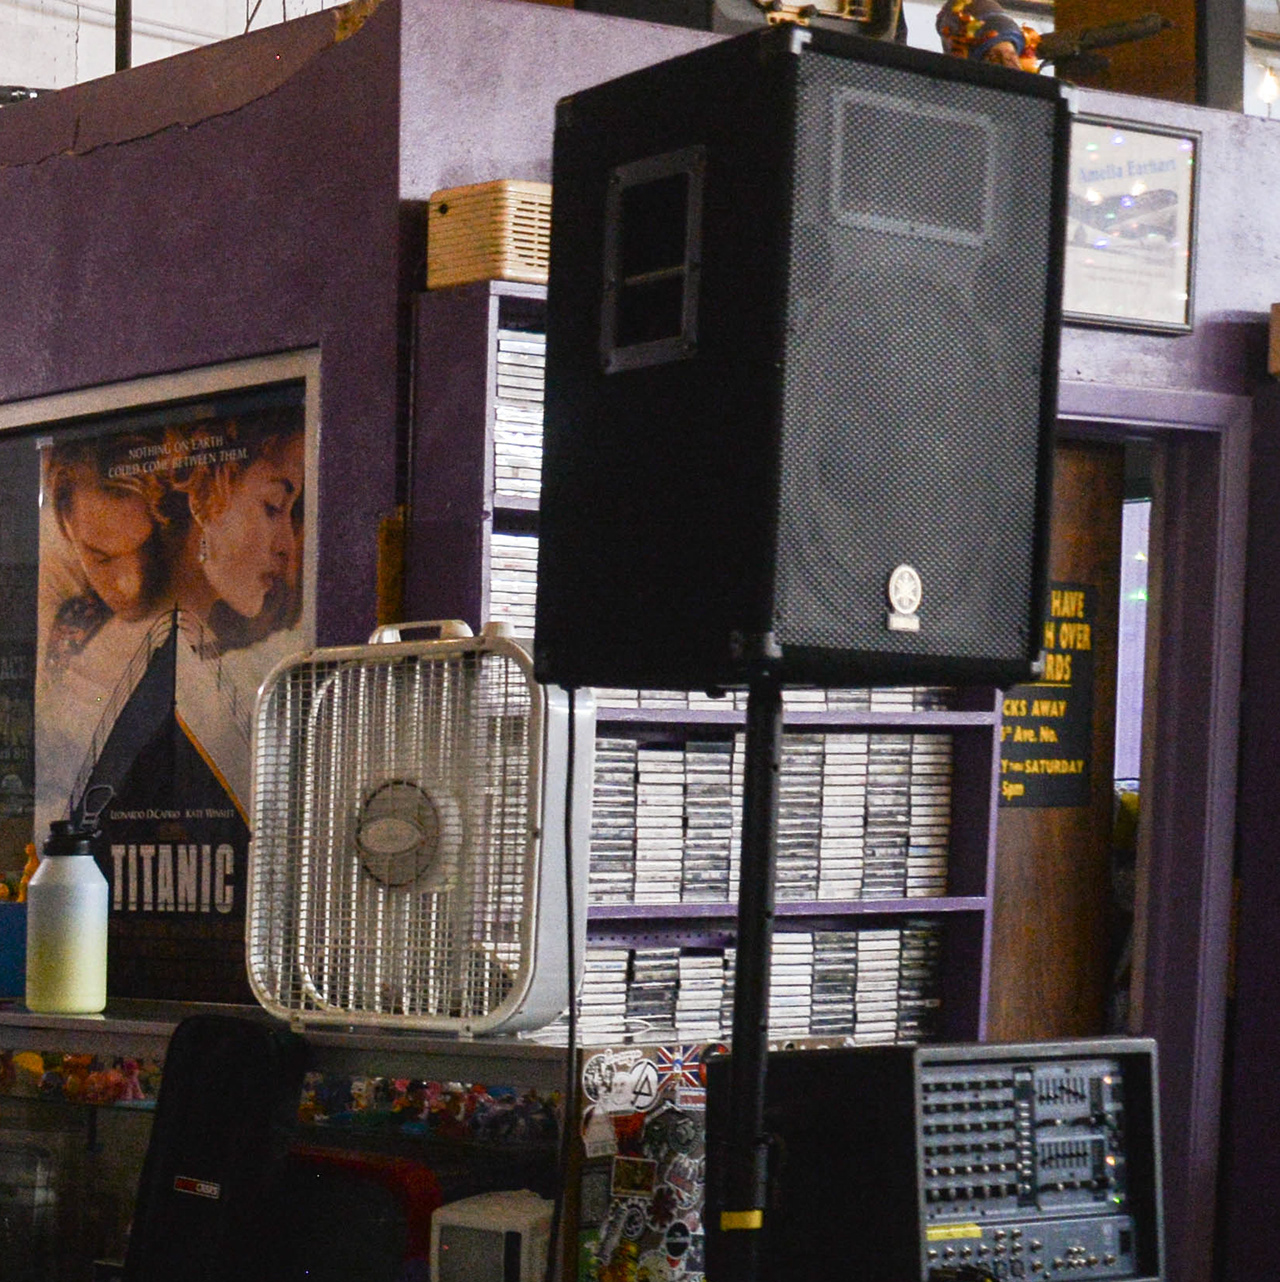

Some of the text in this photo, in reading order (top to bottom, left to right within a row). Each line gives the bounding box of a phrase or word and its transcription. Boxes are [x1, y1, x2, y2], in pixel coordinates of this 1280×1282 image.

[1128, 158, 1177, 177] Earhart
[129, 435, 224, 459] NOTHING ON EARTH
[108, 463, 140, 478] COULD
[142, 460, 168, 473] COME
[173, 452, 216, 469] BETWEEN
[1050, 590, 1085, 619] HAVE
[1059, 622, 1092, 650] OVER
[1002, 699, 1067, 717] CKS AWAY
[1025, 759, 1085, 774] SATURDAY
[185, 809, 203, 819] KATE
[110, 843, 235, 914] TITANIC
